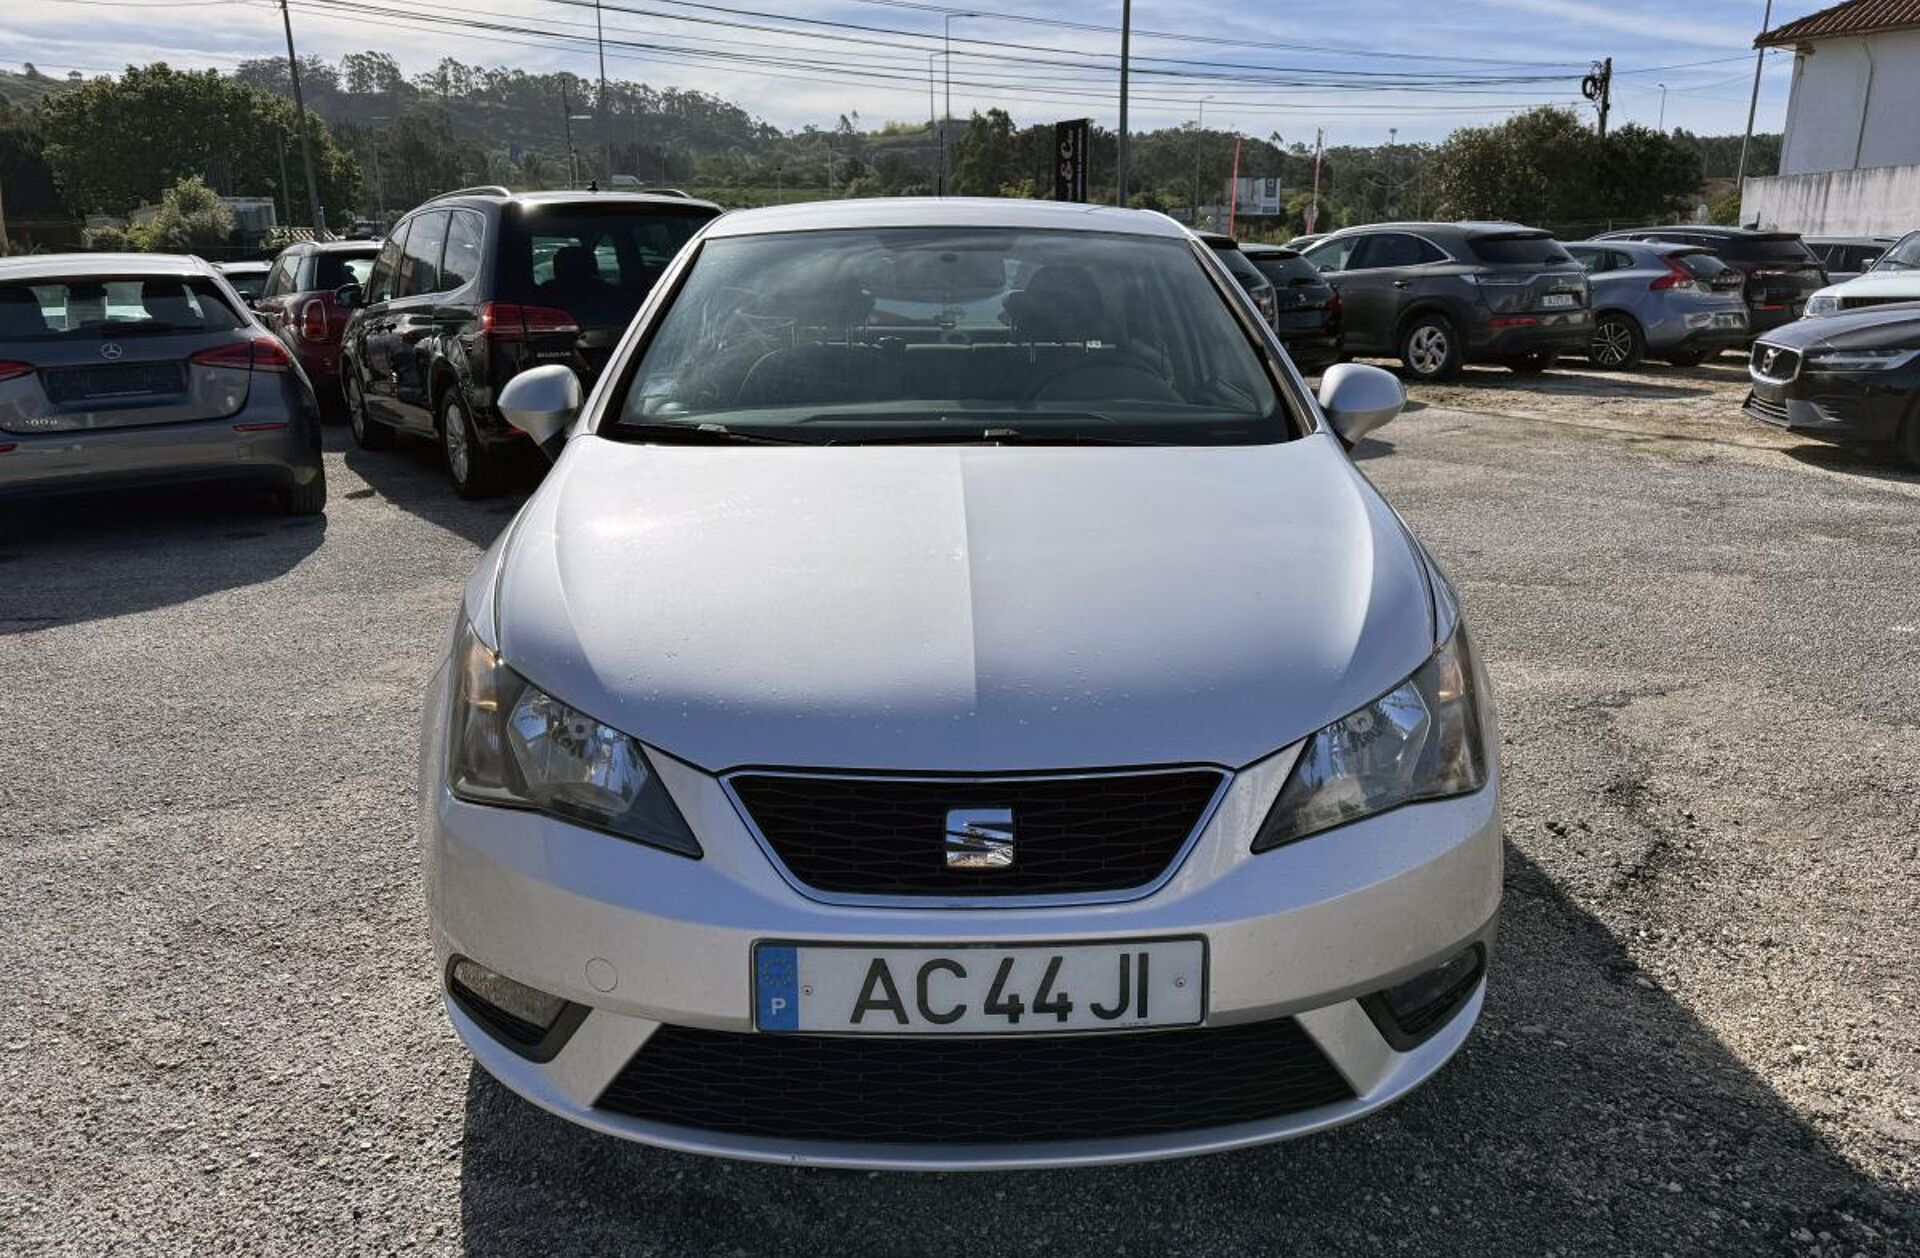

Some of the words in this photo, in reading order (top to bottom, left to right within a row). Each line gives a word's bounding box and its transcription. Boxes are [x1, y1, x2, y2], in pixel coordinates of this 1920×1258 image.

[771, 998, 786, 1015] P
[849, 958, 967, 1024] AC
[983, 956, 1073, 1023] 44
[1090, 952, 1149, 1020] JI
